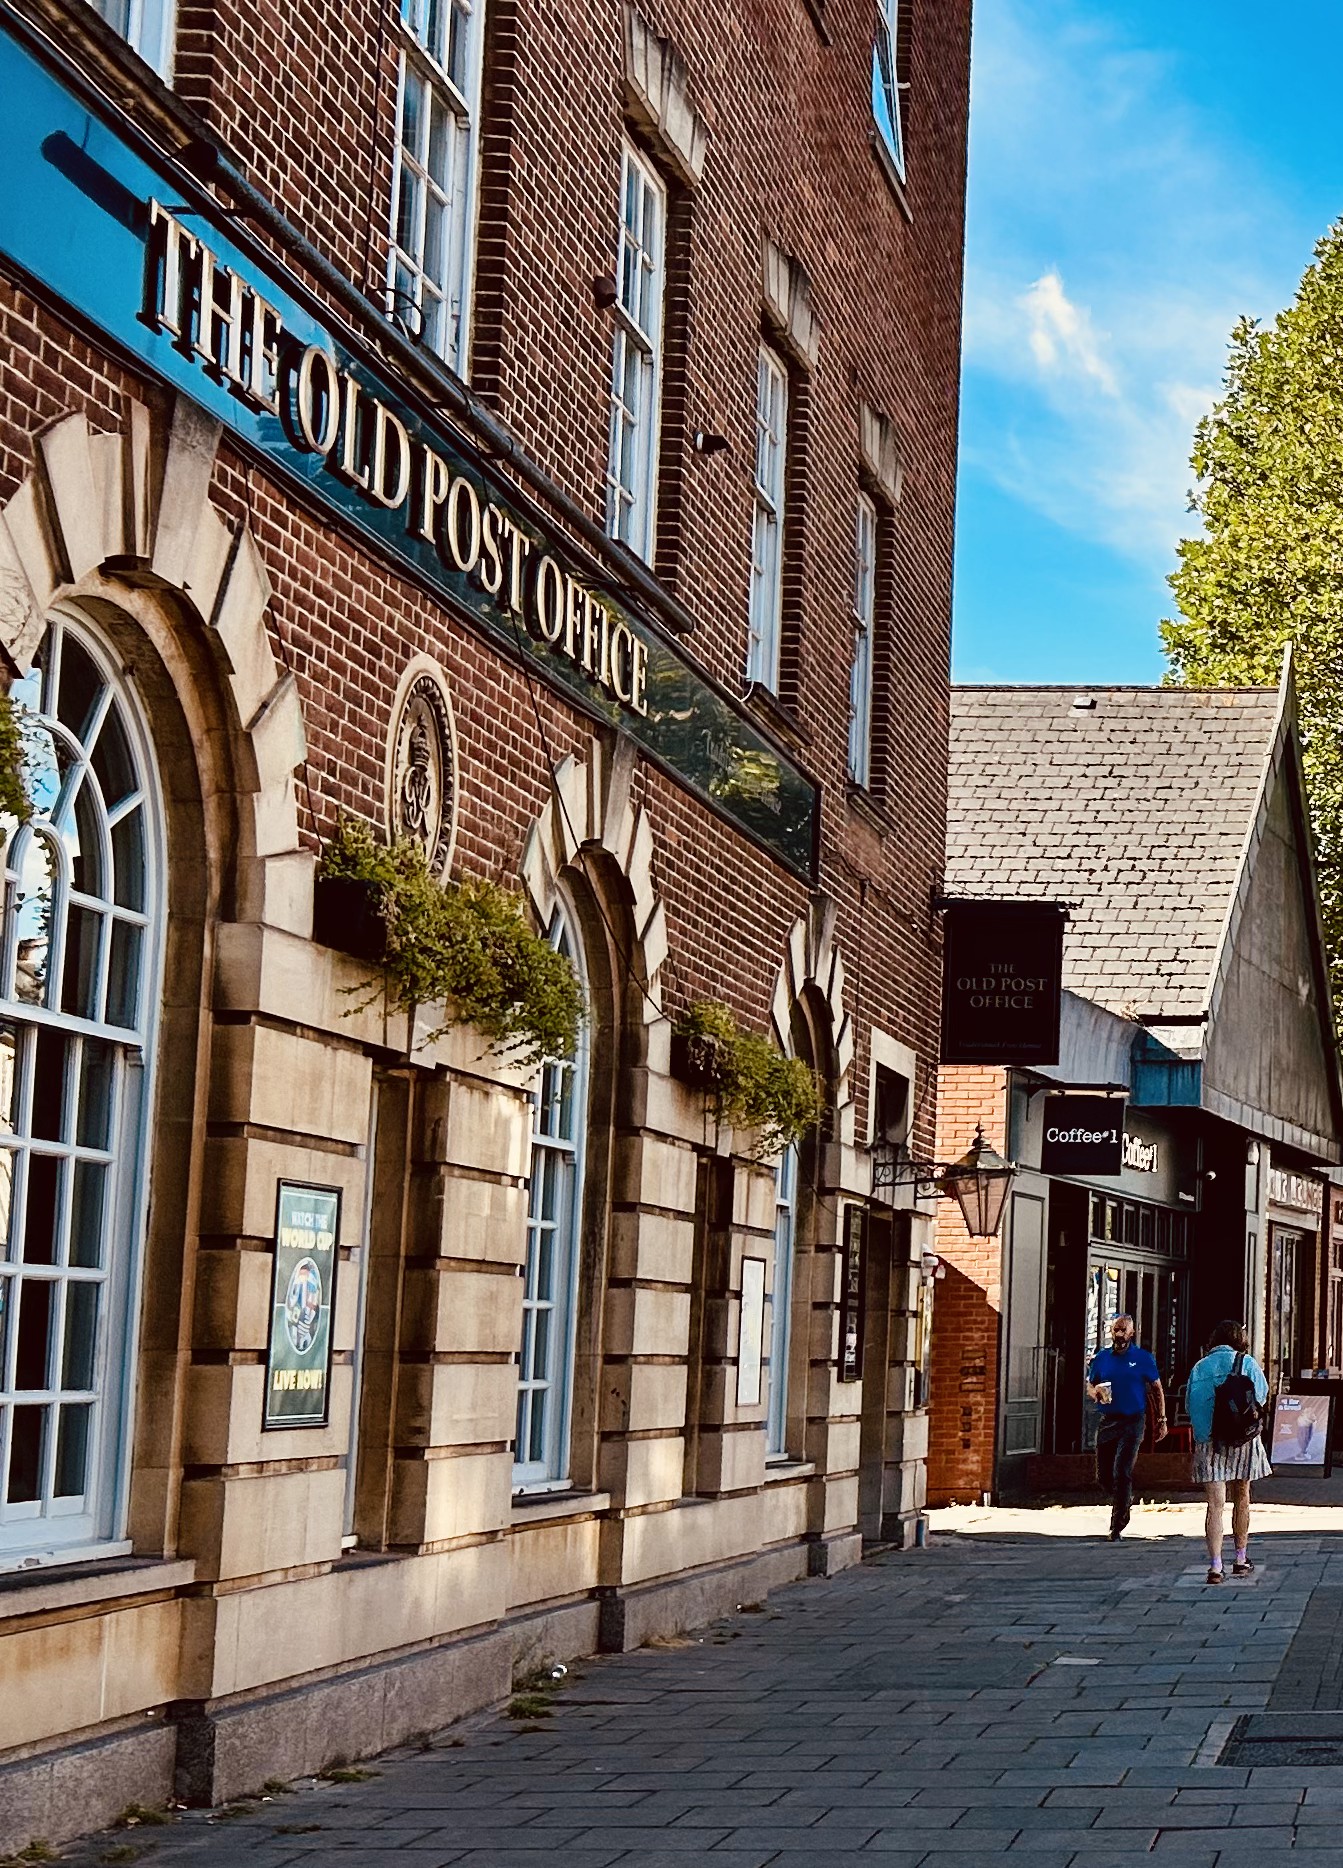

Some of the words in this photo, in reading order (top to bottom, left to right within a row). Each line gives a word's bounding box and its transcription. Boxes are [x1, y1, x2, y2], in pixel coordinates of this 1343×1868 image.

[150, 196, 282, 417] THE
[298, 343, 412, 510] OLD
[420, 442, 530, 615] POST
[535, 554, 649, 718] OFFICE
[988, 963, 1017, 974] THE
[956, 977, 996, 991] OLD
[1000, 977, 1048, 991] POST
[969, 995, 1034, 1009] OFFICE
[281, 1227, 316, 1249] WORLD
[316, 1230, 333, 1251] CUP
[272, 1368, 296, 1391] LIVE
[296, 1369, 323, 1391] NOW!
